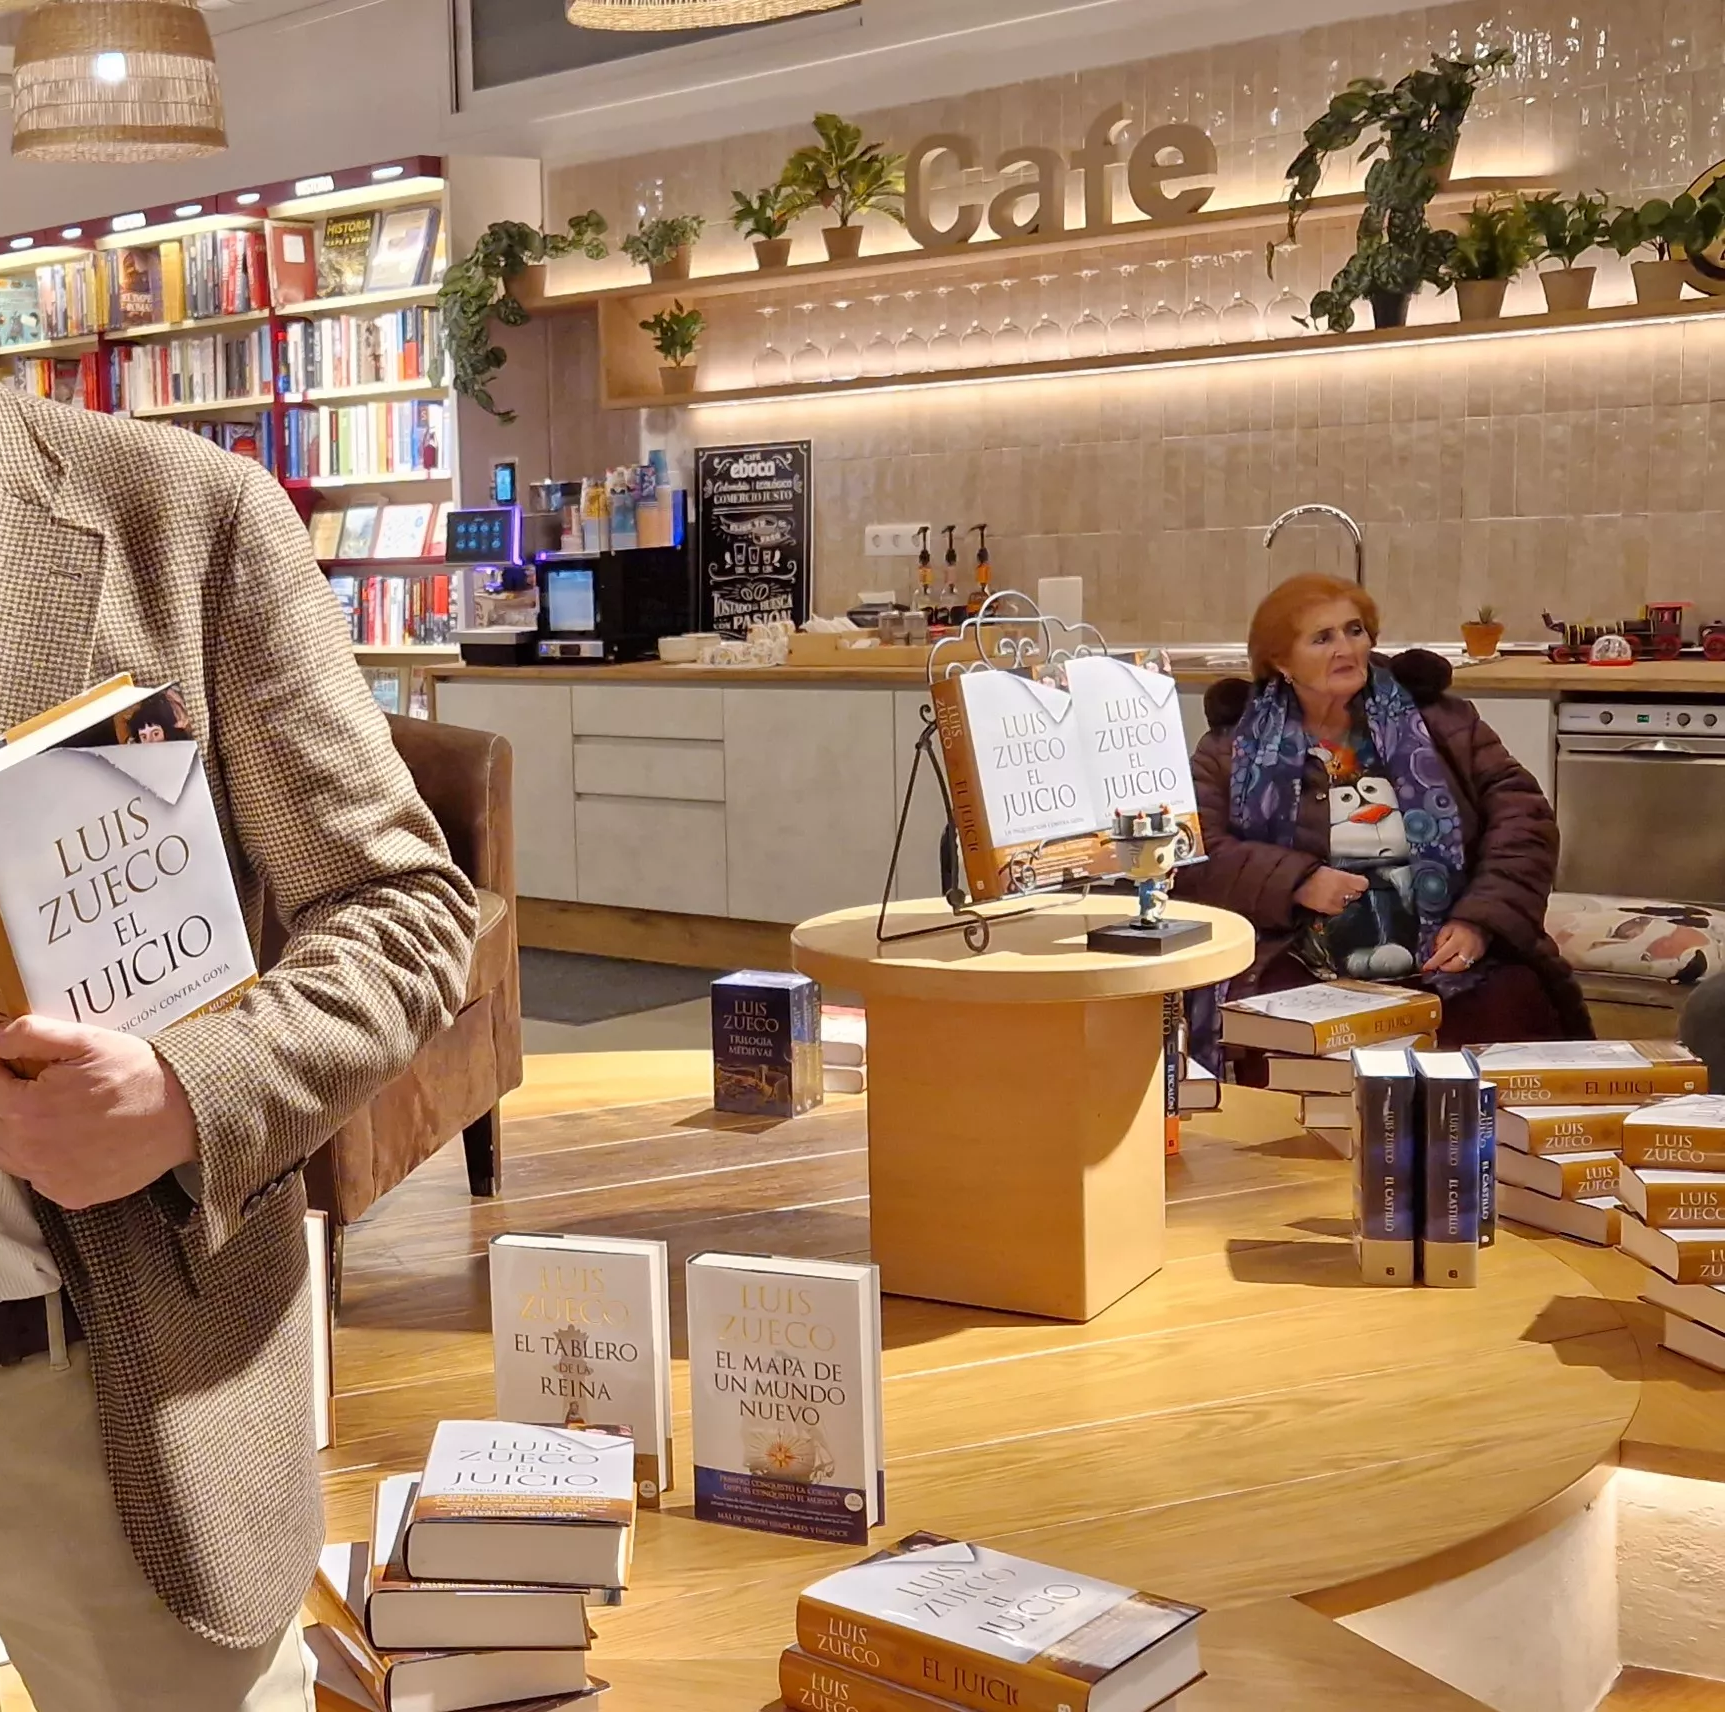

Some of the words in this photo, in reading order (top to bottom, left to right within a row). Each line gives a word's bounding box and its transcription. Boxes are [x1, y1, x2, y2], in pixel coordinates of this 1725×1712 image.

[904, 102, 1218, 246] Cafe
[714, 492, 762, 504] COMERCIO
[763, 490, 793, 502] JUSTO
[947, 704, 963, 738] LUIS
[1105, 694, 1150, 723] LUIS
[1002, 711, 1047, 739] LUIS
[1095, 721, 1167, 753] ZUECO
[993, 737, 1065, 769] ZUECO
[1129, 752, 1145, 768] EL
[1027, 769, 1044, 786] EL
[1103, 767, 1177, 807] JUICIO
[1003, 784, 1076, 825] JUICIO
[54, 796, 150, 880] LUIS
[38, 834, 190, 945] ZUECO
[112, 911, 147, 947] EL
[64, 914, 212, 1024] JUICIO
[159, 980, 202, 1010] CONTRA
[203, 962, 231, 984] GOYA
[734, 1000, 768, 1016] LUIS
[723, 1014, 779, 1033] ZUECO
[1330, 1023, 1351, 1038] LUIS
[1374, 1019, 1386, 1033] EL
[728, 1046, 773, 1057] MEDIEVAL
[729, 1034, 773, 1047] TRILOGÍA
[1326, 1033, 1357, 1049] ZUECO
[1168, 1064, 1175, 1073] EL
[1167, 1074, 1176, 1109] ESCALÓN
[1500, 1089, 1551, 1101] ZUECO
[1509, 1076, 1541, 1089] LUIS
[1585, 1081, 1600, 1095] EL
[1449, 1113, 1459, 1133] LUIS
[1554, 1122, 1584, 1136] LUIS
[1545, 1135, 1593, 1148] ZUECO
[1655, 1133, 1693, 1148] LUIS
[1482, 1160, 1489, 1172] EL
[1643, 1147, 1705, 1163] ZUECO
[1384, 1176, 1395, 1186] EL
[1448, 1179, 1459, 1189] EL
[1586, 1166, 1614, 1180] LUIS
[1385, 1187, 1395, 1232] CASTILLO
[1680, 1191, 1718, 1206] LUIS
[1448, 1190, 1459, 1235] CASTILLO
[540, 1266, 605, 1295] LUIS
[519, 1294, 629, 1327] ZUECO
[741, 1285, 813, 1316] LUIS
[718, 1316, 836, 1352] ZUECO
[514, 1333, 535, 1353] EL
[541, 1336, 638, 1363] TABLERO
[559, 1362, 575, 1374] DE
[577, 1363, 591, 1375] LA
[716, 1350, 736, 1370] EL
[743, 1354, 806, 1379] MAPA
[814, 1361, 842, 1382] DE
[541, 1376, 613, 1401] REINA
[715, 1373, 747, 1393] UN
[755, 1379, 845, 1406] MUNDO
[740, 1400, 820, 1426] NUEVO
[458, 1450, 599, 1465] ZUECO
[491, 1440, 572, 1452] LUIS
[453, 1472, 599, 1486] JUICIO
[515, 1464, 541, 1473] EL
[896, 1564, 966, 1598] LUIS
[914, 1567, 1017, 1618] ZUECO
[984, 1595, 1016, 1609] EL
[828, 1617, 868, 1645] LUIS
[817, 1634, 880, 1668] ZUECO
[923, 1656, 945, 1683] EL
[811, 1672, 849, 1701] LUIS
